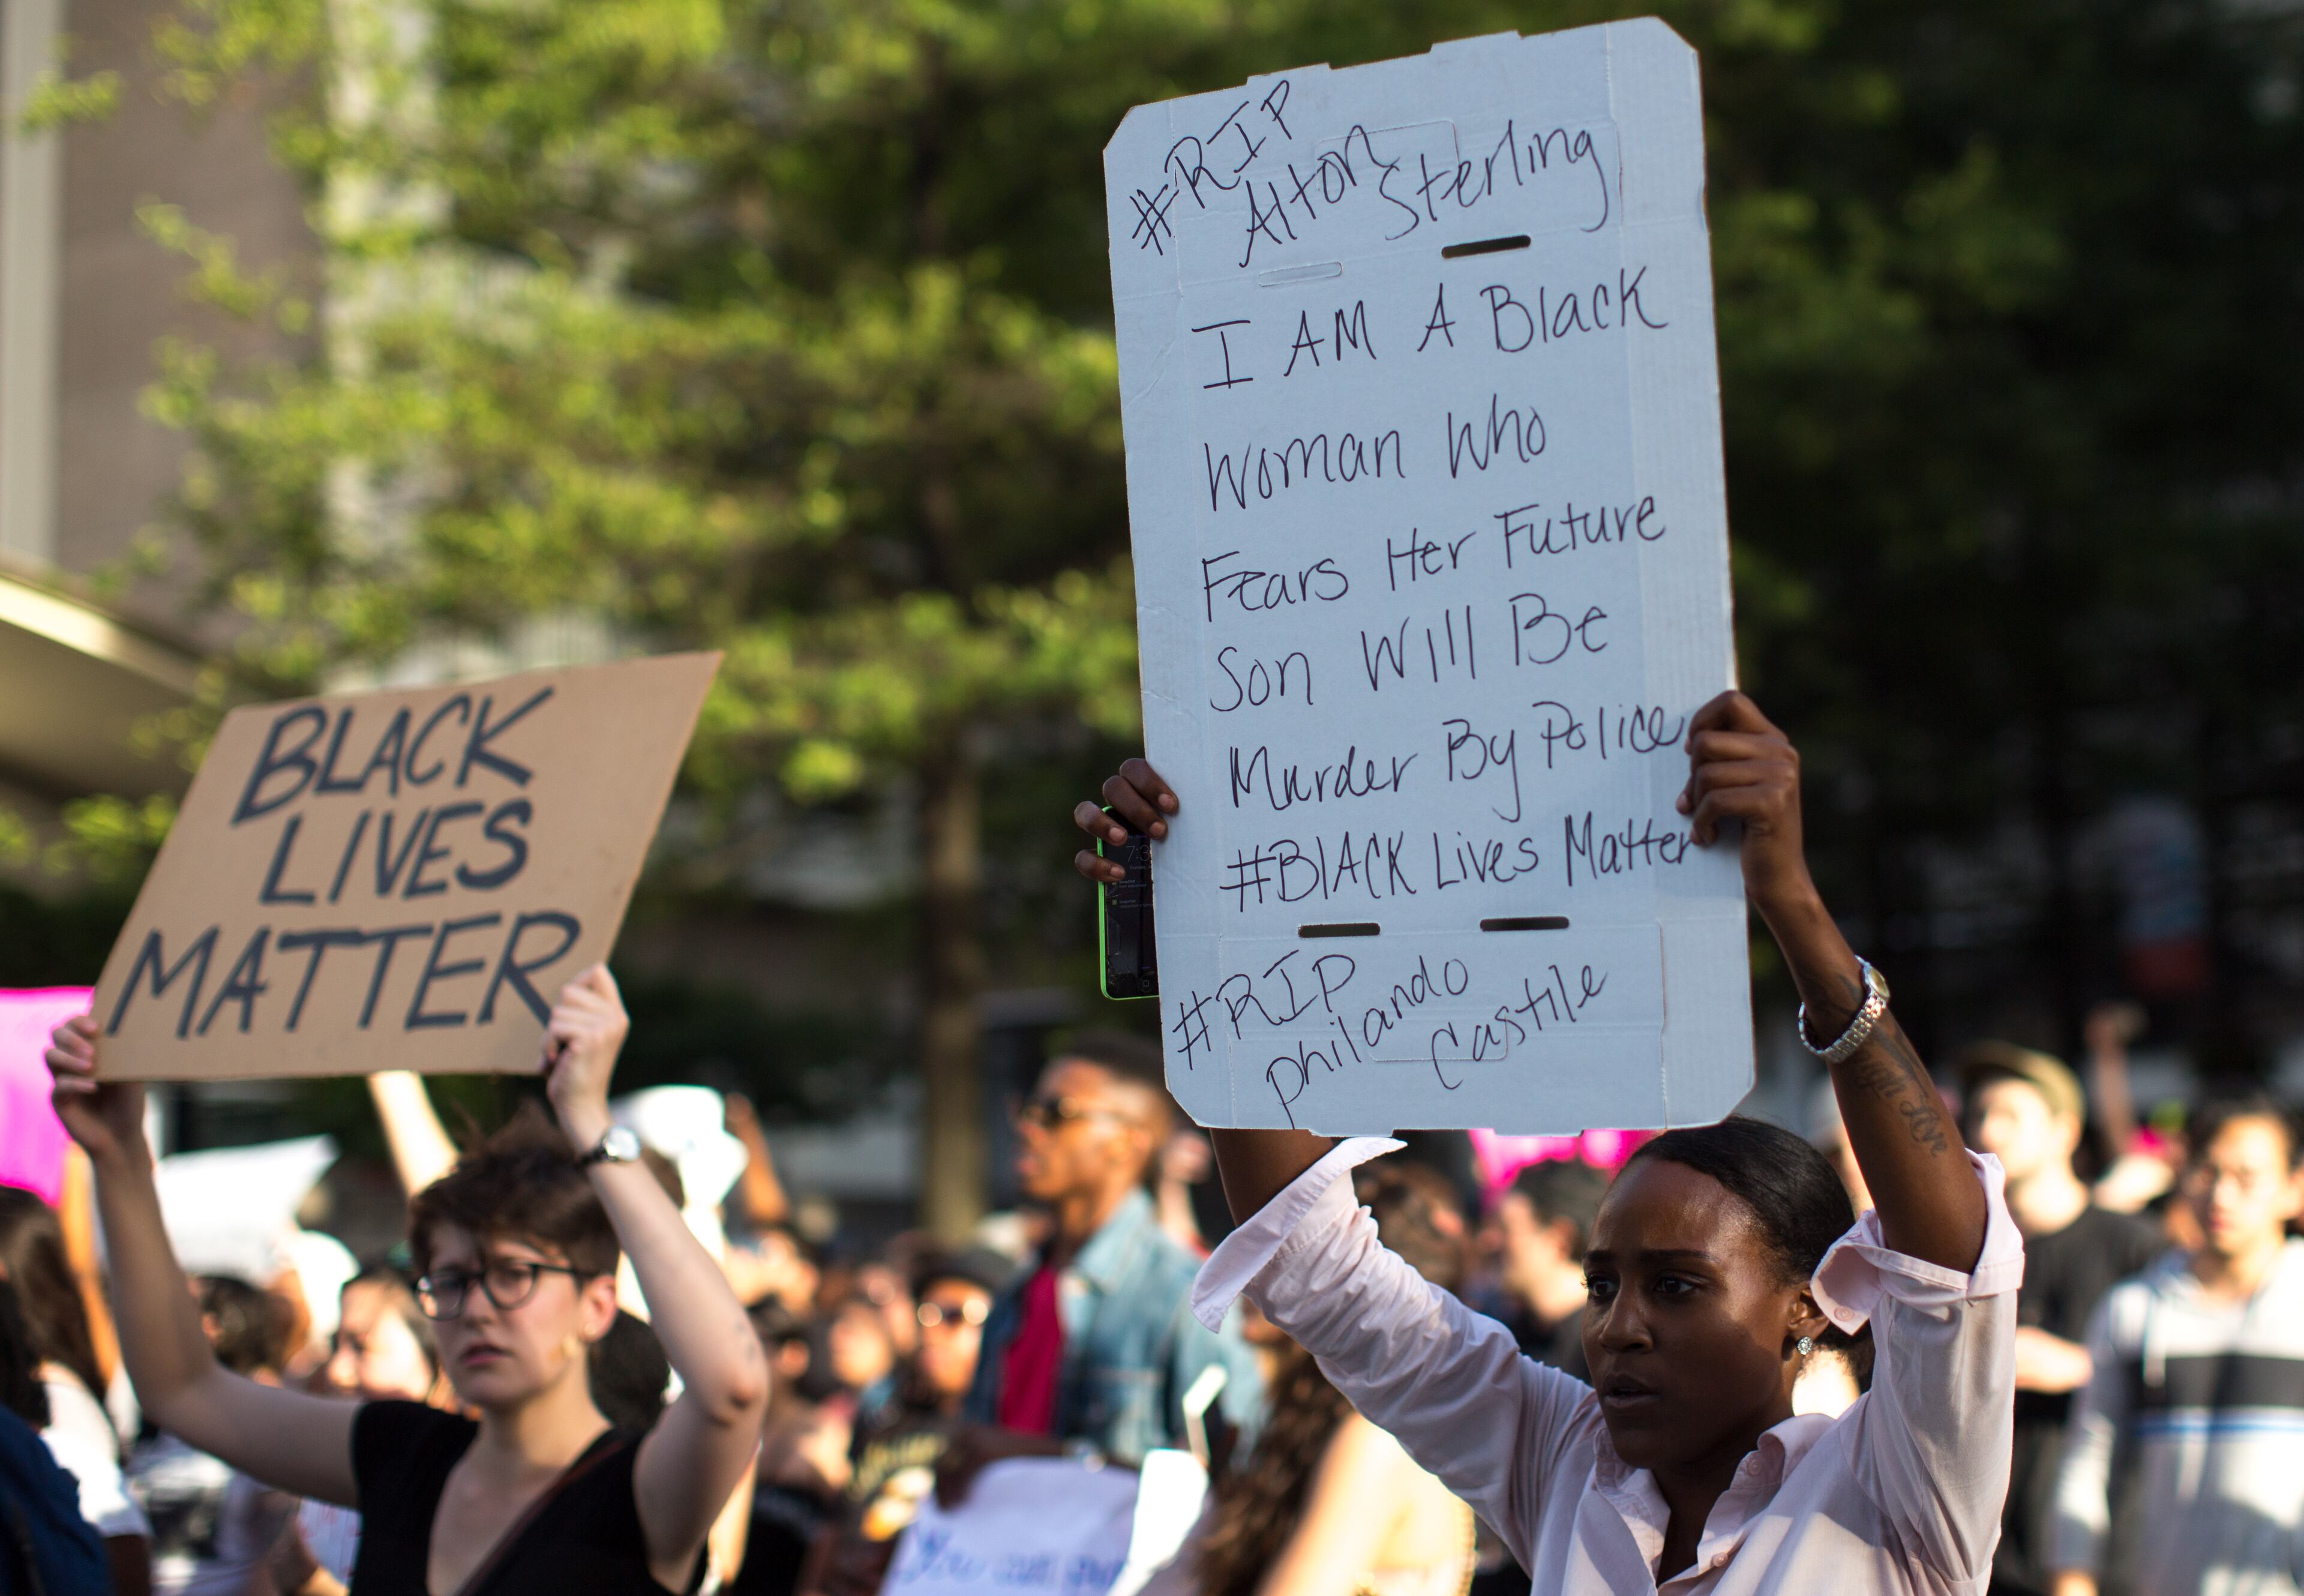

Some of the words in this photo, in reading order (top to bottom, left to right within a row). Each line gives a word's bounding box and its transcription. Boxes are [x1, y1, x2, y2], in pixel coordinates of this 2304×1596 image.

[1129, 78, 1292, 255] #RIP
[1238, 124, 1399, 268] Alton
[1378, 119, 1609, 239] Sterling
[1191, 320, 1253, 389] I
[1283, 300, 1376, 377] AM
[1417, 283, 1456, 352] A
[1204, 430, 1406, 512] Woman
[1448, 394, 1546, 479] Who
[1202, 551, 1348, 622] Fears
[1387, 528, 1477, 591] Her
[1493, 496, 1666, 569] Future
[1210, 646, 1314, 712] Son
[1361, 605, 1475, 691] Will
[1508, 593, 1608, 666] Be
[230, 685, 554, 826] BLACK
[1230, 745, 1418, 811] Murder
[1442, 719, 1521, 823] By
[1532, 701, 1684, 769] Police
[259, 799, 535, 905] LIVES
[1126, 845, 1150, 862] 7:3
[1433, 832, 1539, 890] Lives
[1565, 811, 1690, 886] Matter
[106, 910, 581, 1040] MATTER
[1172, 949, 1356, 1071] #RIP
[1431, 964, 1607, 1090] Castile
